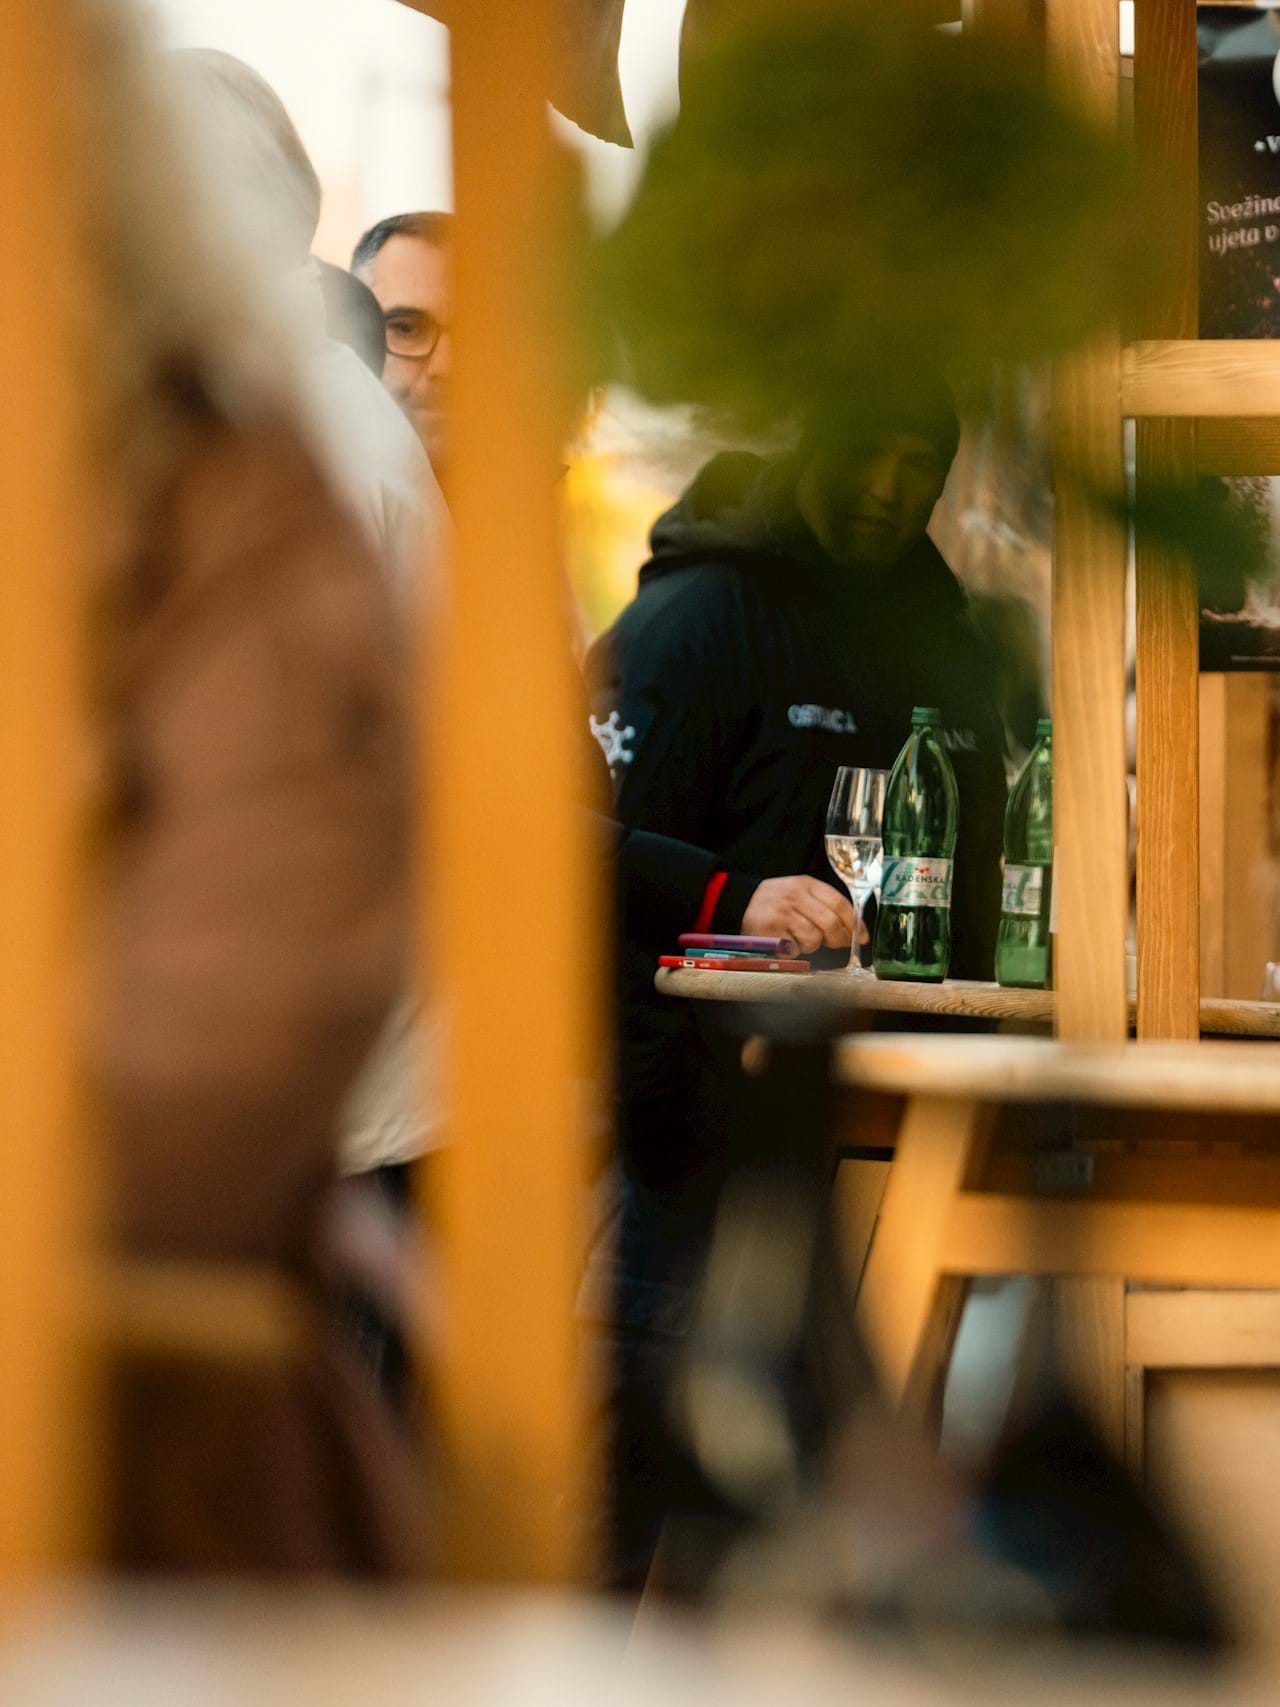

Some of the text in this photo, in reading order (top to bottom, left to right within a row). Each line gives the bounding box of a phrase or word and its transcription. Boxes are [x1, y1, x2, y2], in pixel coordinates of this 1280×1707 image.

[1209, 226, 1260, 254] ujeta
[1265, 224, 1278, 240] v
[896, 874, 945, 884] RADENSKA
